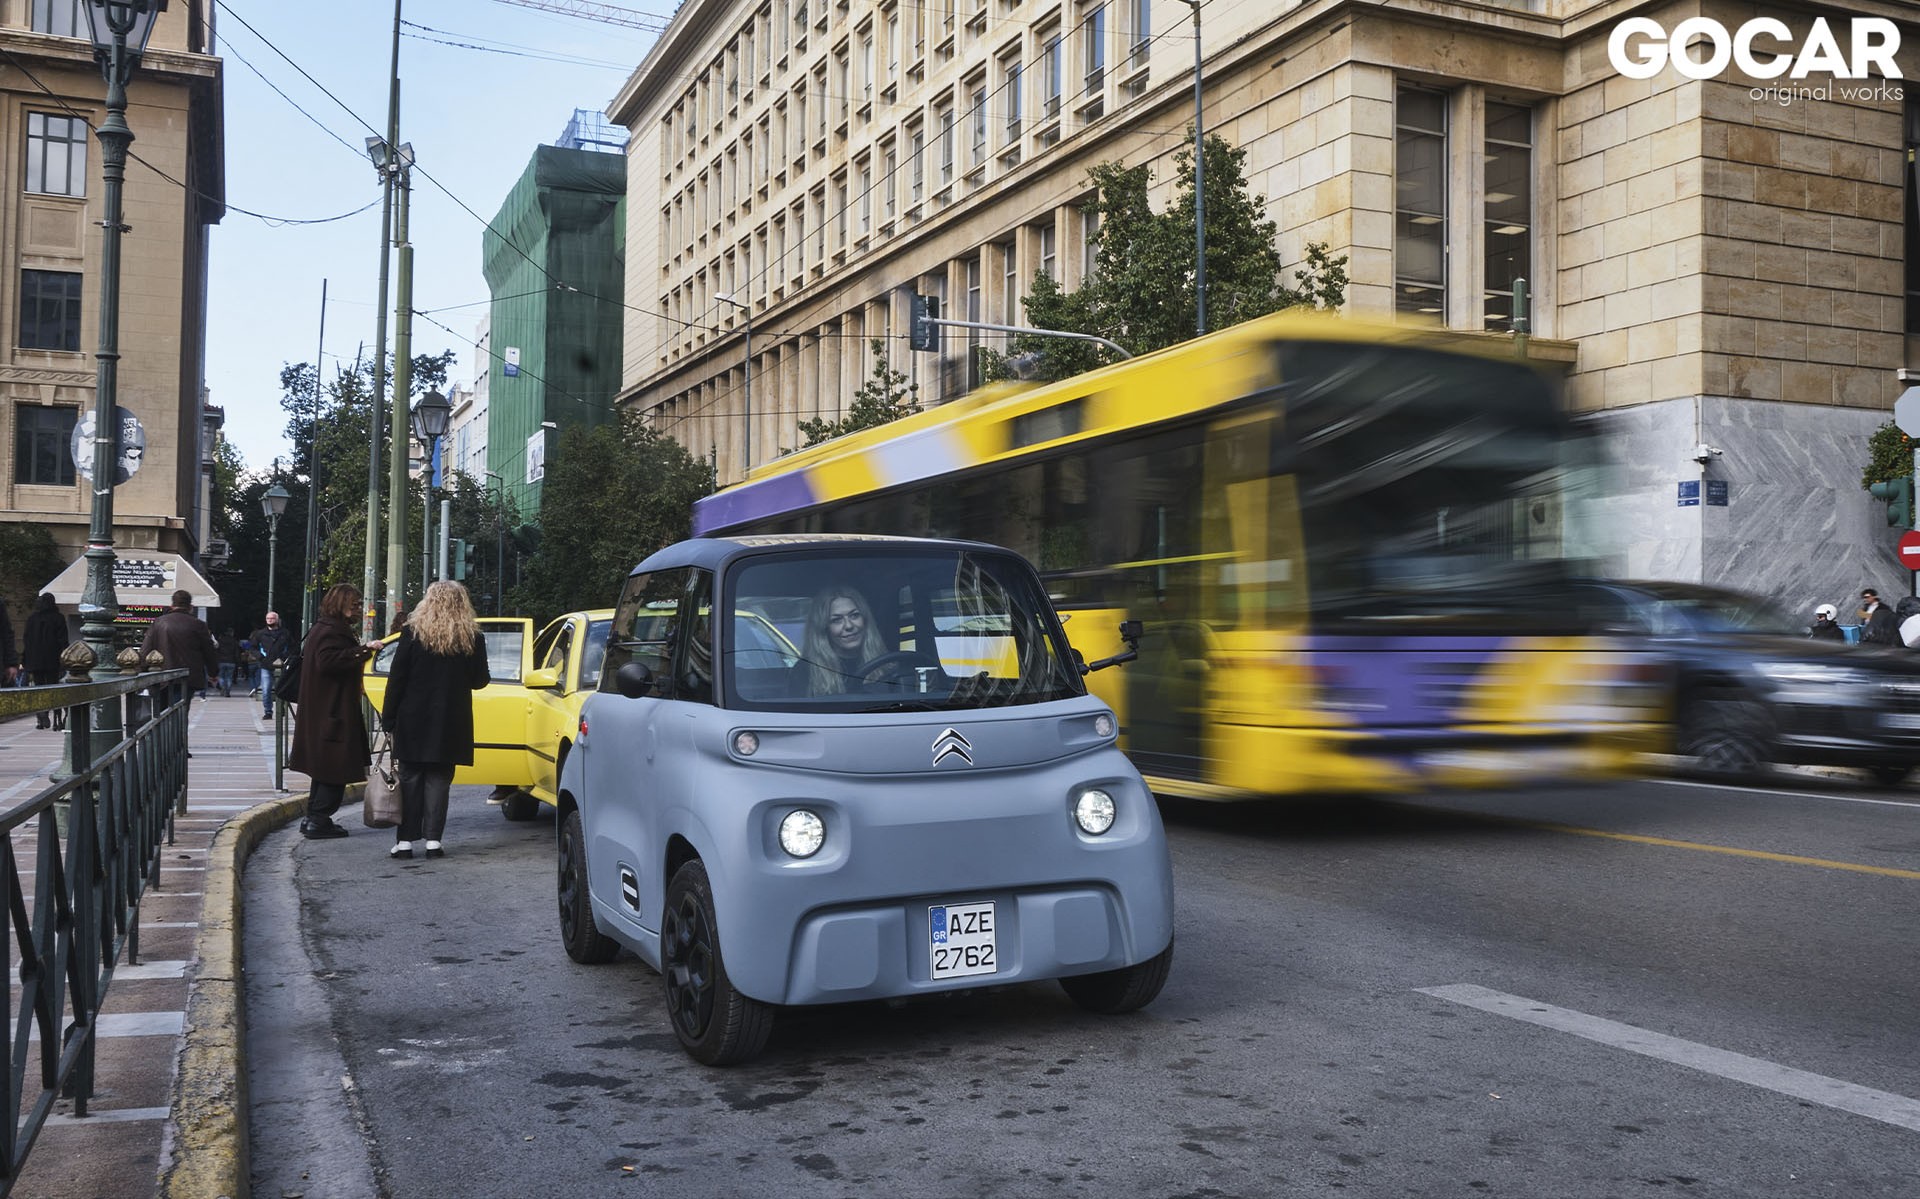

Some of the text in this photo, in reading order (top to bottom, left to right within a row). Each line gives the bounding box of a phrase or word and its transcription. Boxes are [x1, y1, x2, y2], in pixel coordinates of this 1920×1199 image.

[933, 931, 946, 941] GR
[949, 910, 993, 936] AZE
[934, 944, 994, 971] 2762
